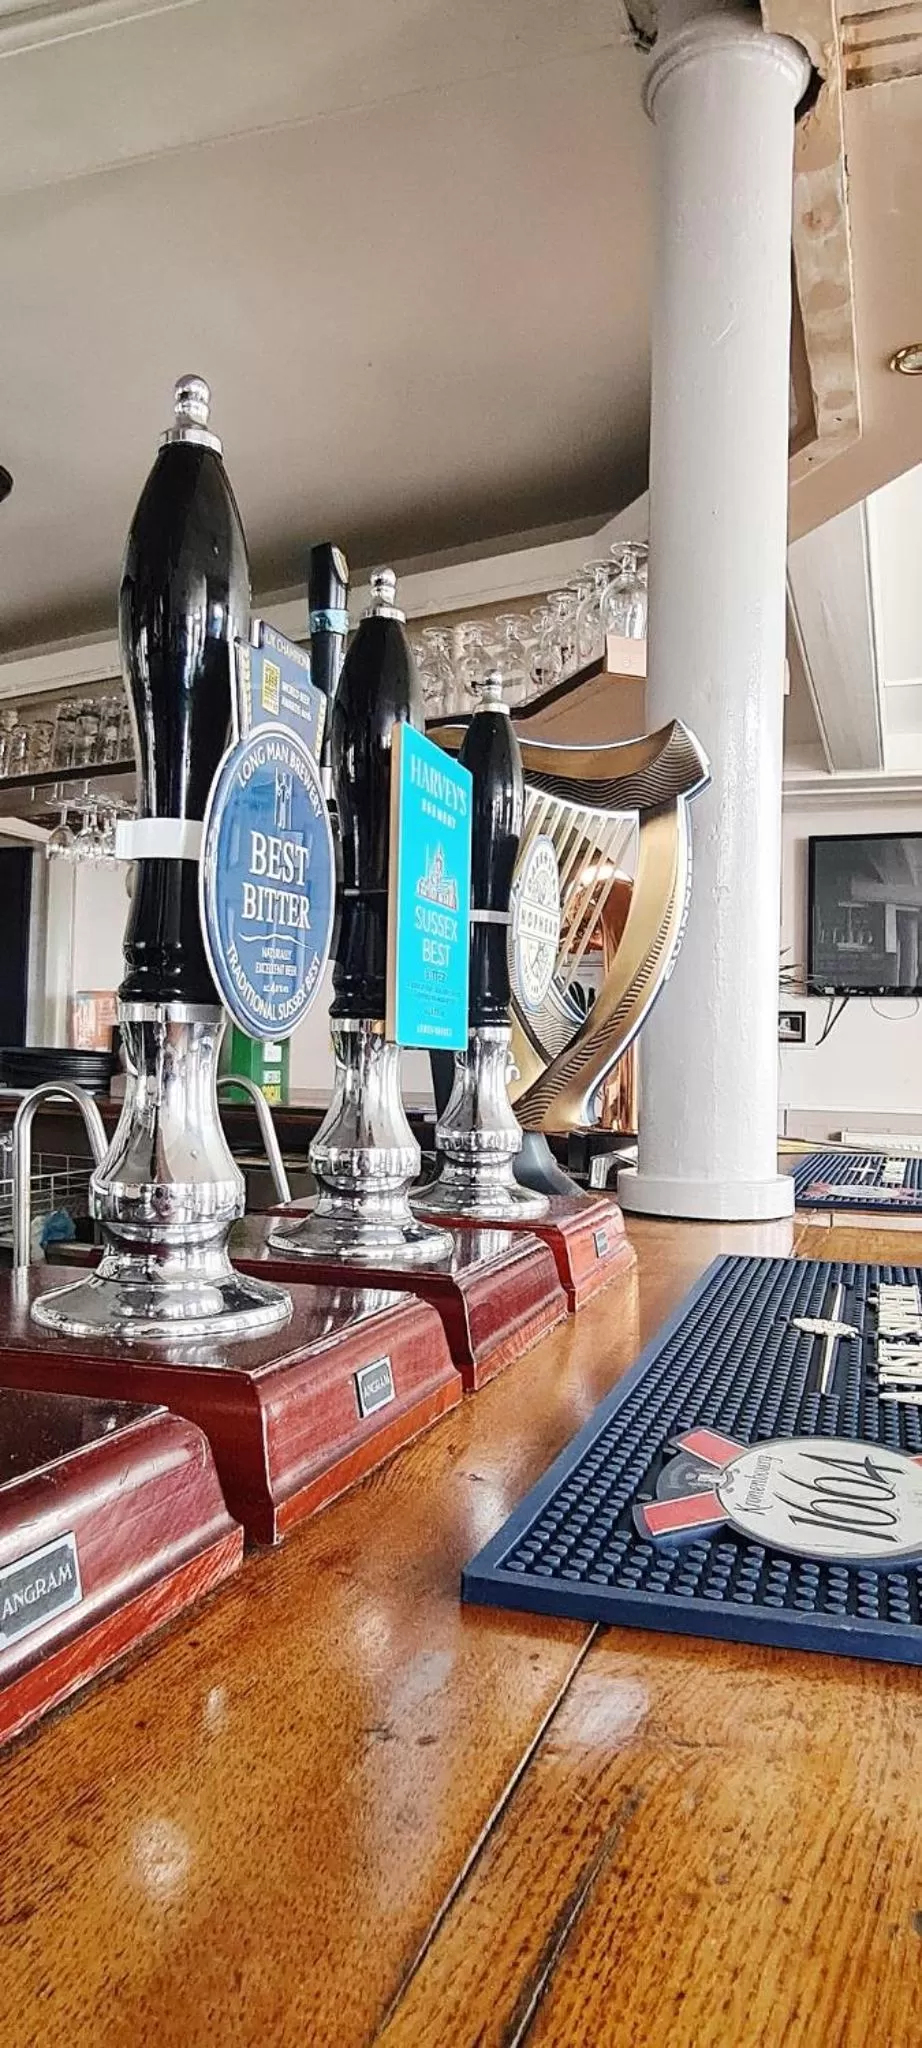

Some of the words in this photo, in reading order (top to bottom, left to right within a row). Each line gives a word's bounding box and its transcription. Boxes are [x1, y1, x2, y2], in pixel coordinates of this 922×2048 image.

[237, 747, 265, 789] LONG
[267, 742, 289, 764] MAN
[289, 750, 323, 818] BREWERY
[410, 753, 467, 817] HARVEY'S
[248, 829, 310, 886] BEST
[241, 882, 312, 929] BITTER
[414, 904, 458, 943] SUSSEX
[227, 942, 277, 1021] TRADITIONAL
[278, 984, 307, 1021] SUSSEX
[305, 951, 321, 992] BEST
[422, 938, 451, 967] BEST
[734, 1454, 784, 1516] Kronenbourg
[772, 1452, 906, 1543] 1664
[2, 1563, 73, 1620] ANGRAM
